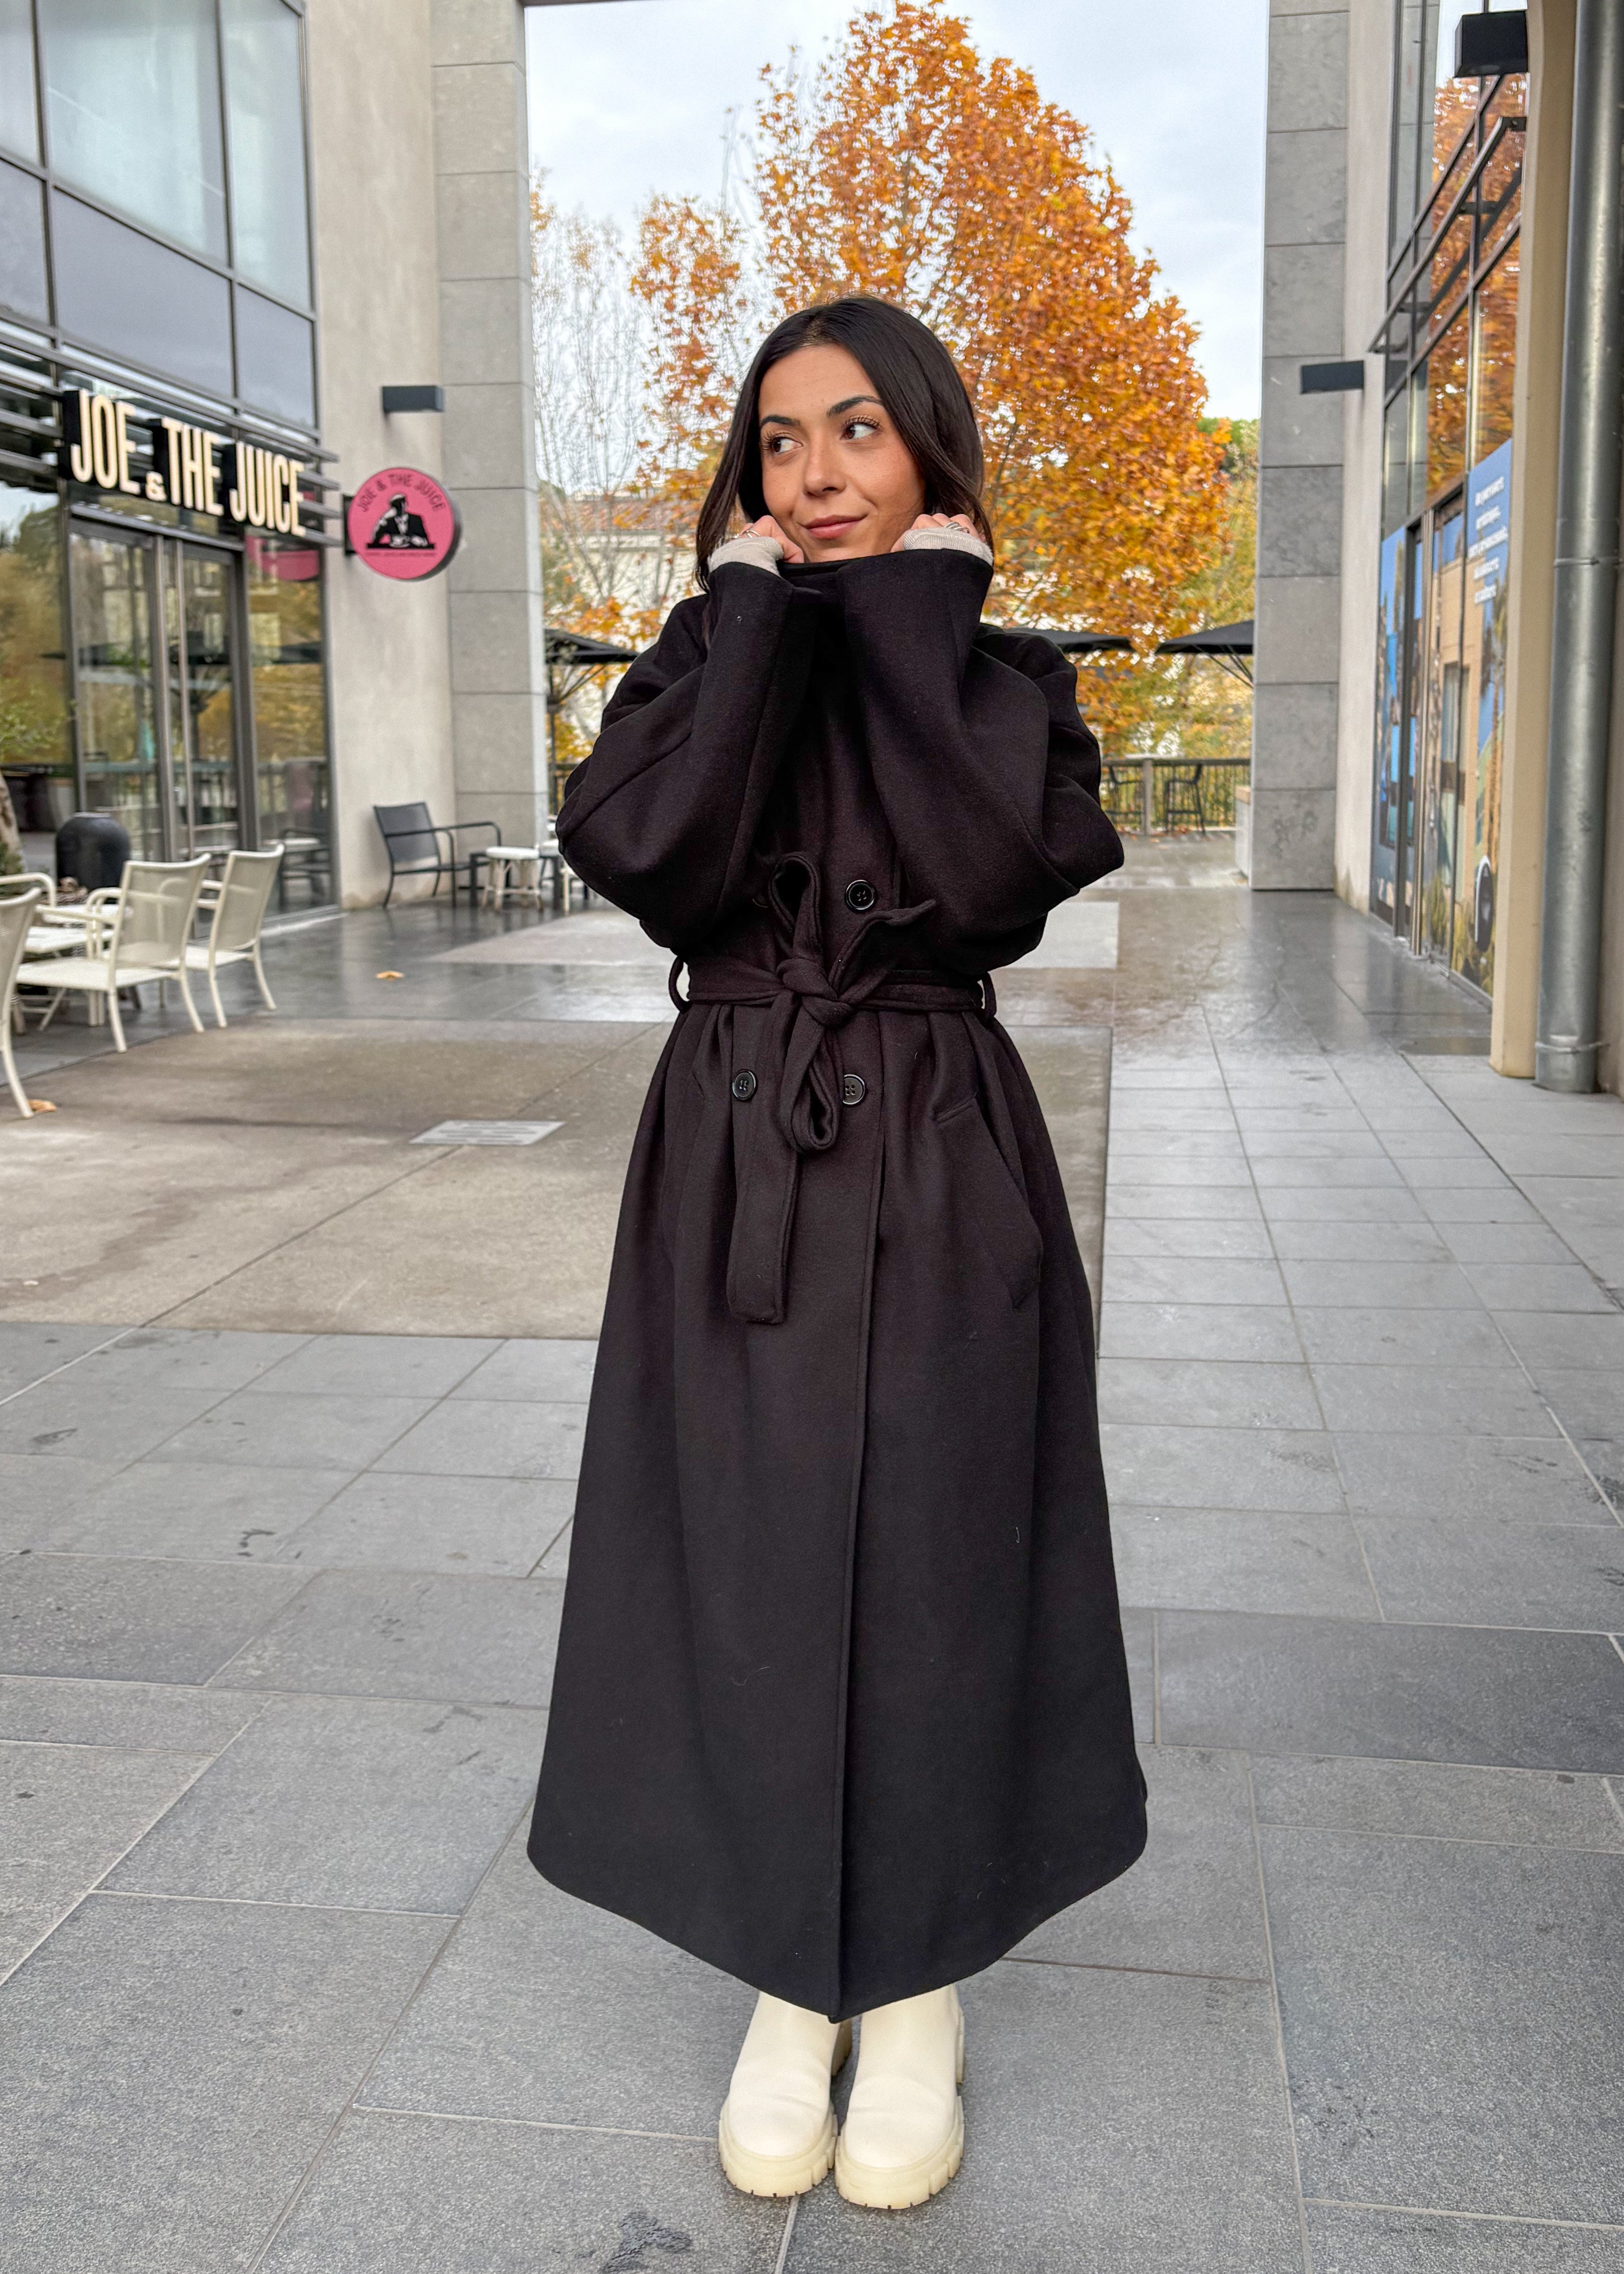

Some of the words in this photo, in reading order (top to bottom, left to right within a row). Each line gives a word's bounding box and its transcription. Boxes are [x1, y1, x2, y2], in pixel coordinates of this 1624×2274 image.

[70, 389, 141, 495] JOE
[145, 470, 167, 502] &
[161, 416, 224, 516] THE
[229, 441, 306, 537] JUICE
[357, 488, 376, 512] JOE
[376, 480, 387, 491] &
[388, 474, 413, 487] THE
[413, 480, 446, 512] JUICE
